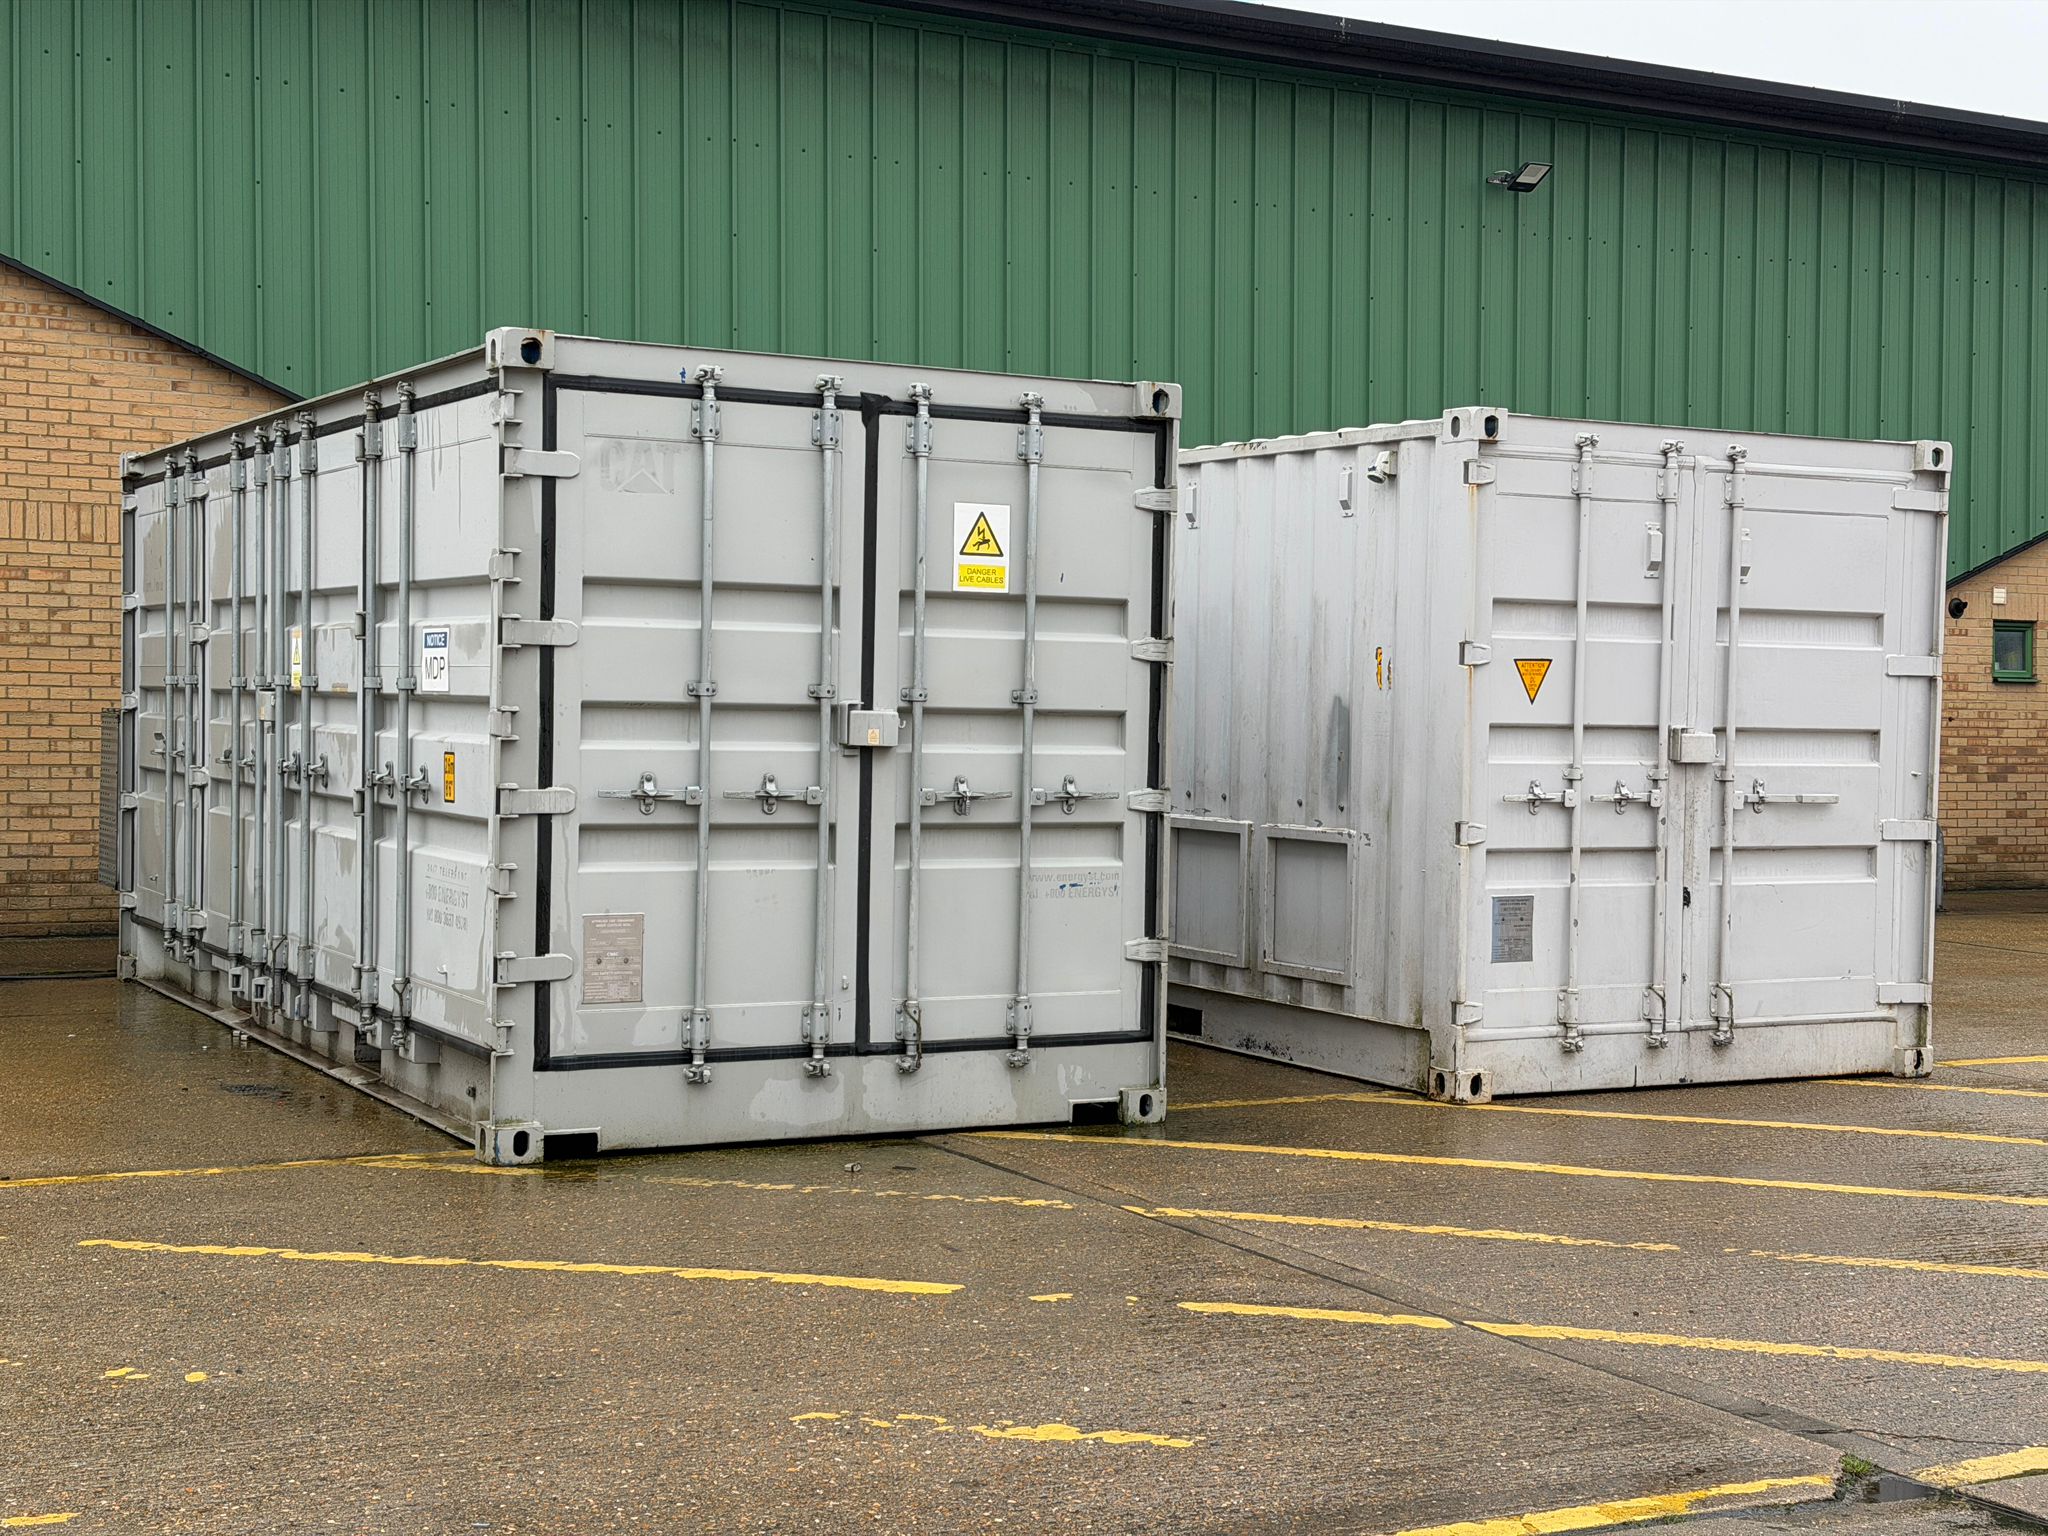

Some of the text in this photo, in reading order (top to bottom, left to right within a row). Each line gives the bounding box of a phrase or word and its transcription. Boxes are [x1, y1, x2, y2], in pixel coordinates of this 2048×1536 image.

[966, 567, 997, 576] DANGER
[959, 575, 1004, 584] LIVE CABLES
[426, 633, 446, 647] NOTICE
[425, 656, 446, 680] MDP
